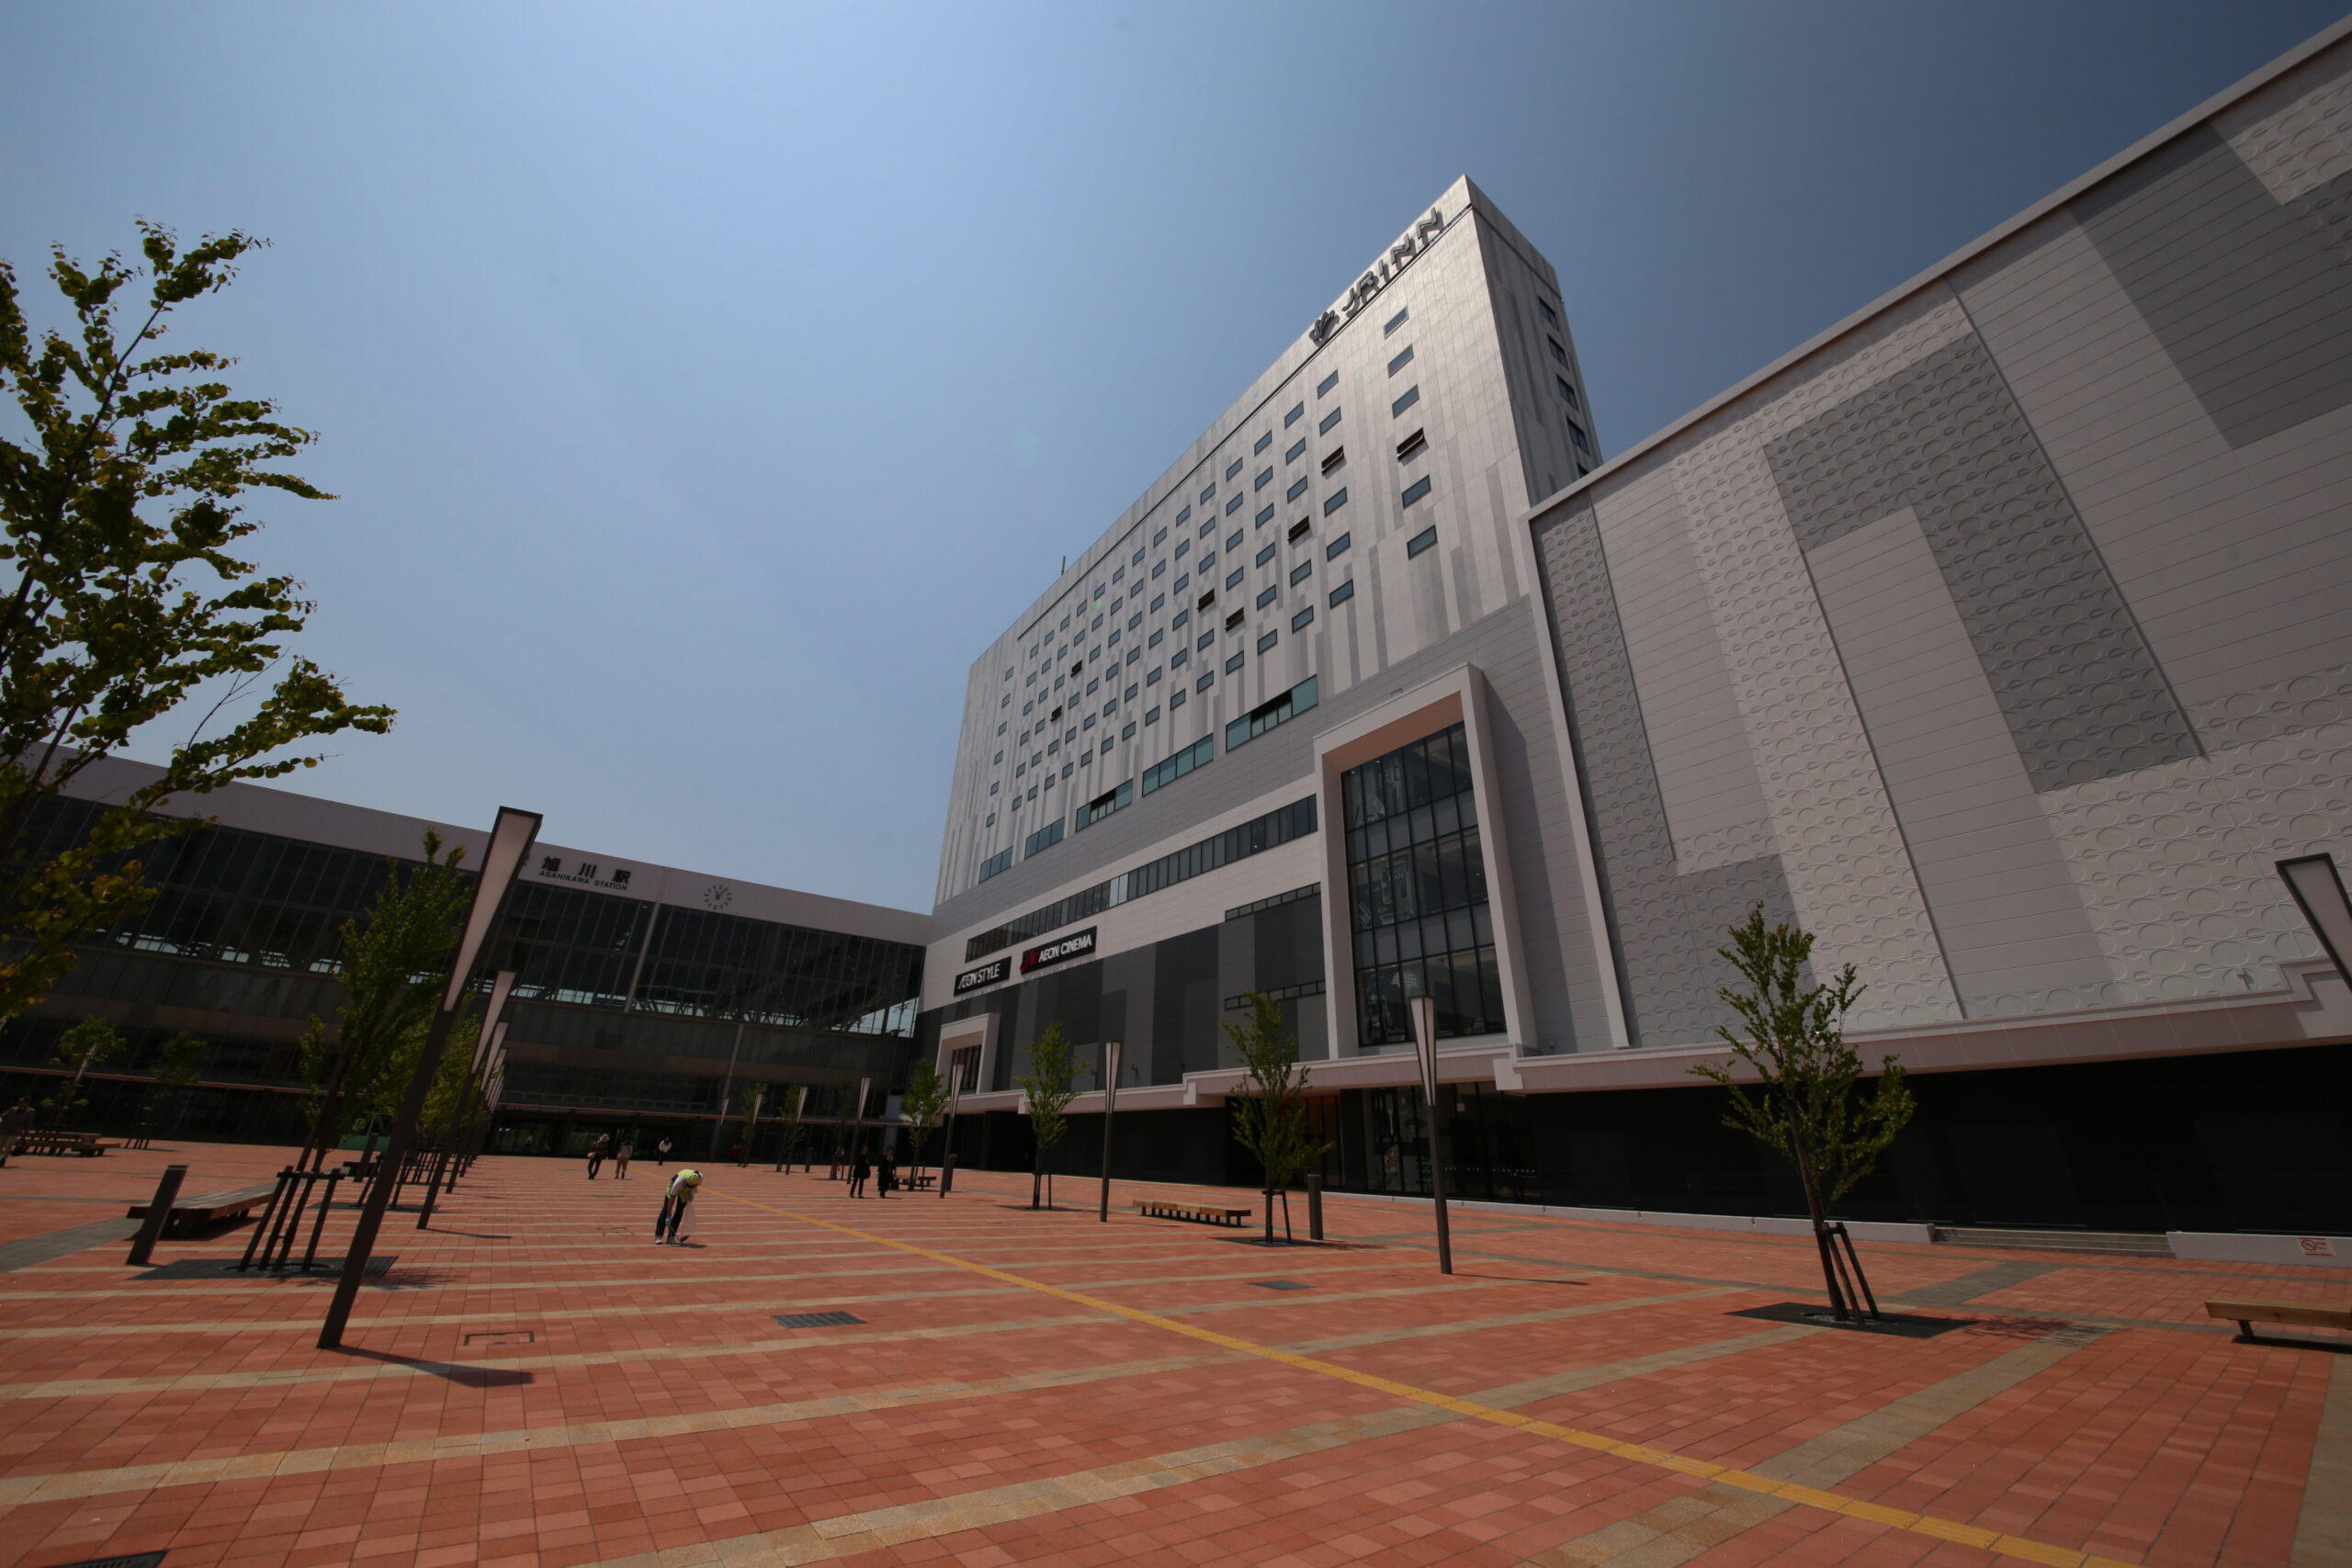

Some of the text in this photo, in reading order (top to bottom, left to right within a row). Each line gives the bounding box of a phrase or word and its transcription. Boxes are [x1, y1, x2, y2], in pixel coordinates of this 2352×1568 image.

[539, 870, 628, 891] ASAHIKAWA STATION
[542, 856, 631, 884] 旭川駅
[1038, 934, 1093, 963] AEON CINEMA
[978, 963, 1001, 983] STYLE
